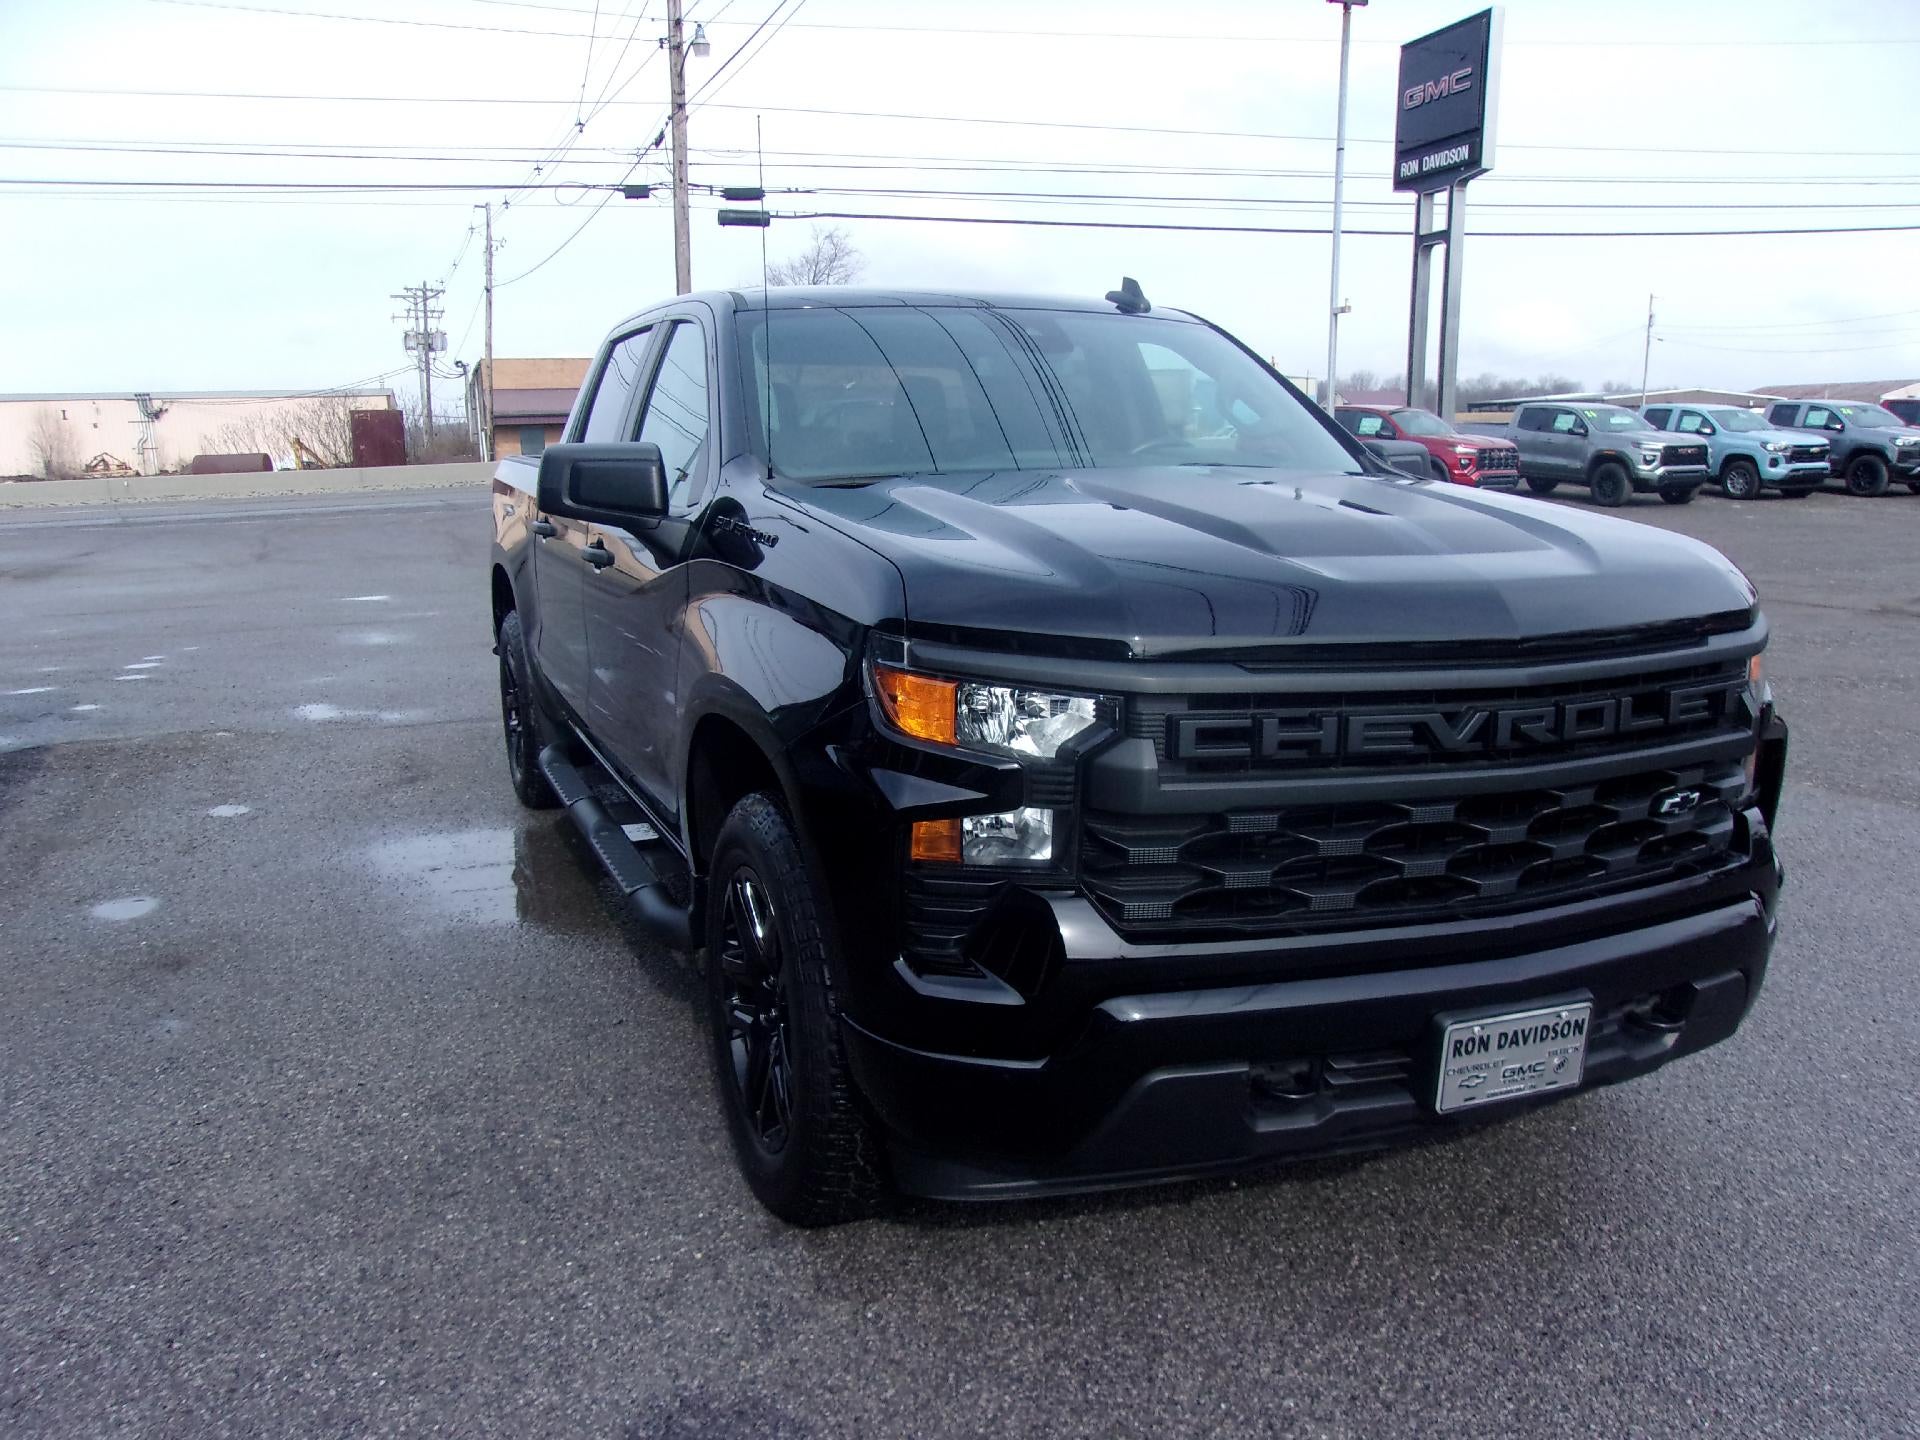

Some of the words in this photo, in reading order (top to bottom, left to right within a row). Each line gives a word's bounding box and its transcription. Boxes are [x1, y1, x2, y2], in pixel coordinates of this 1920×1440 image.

[1404, 67, 1472, 110] GMC
[1400, 159, 1419, 178] RON
[1422, 144, 1469, 171] DAVIDSON
[1453, 1034, 1490, 1058] RON
[1498, 1018, 1585, 1050] DAVIDSON
[1502, 1061, 1546, 1079] GMC
